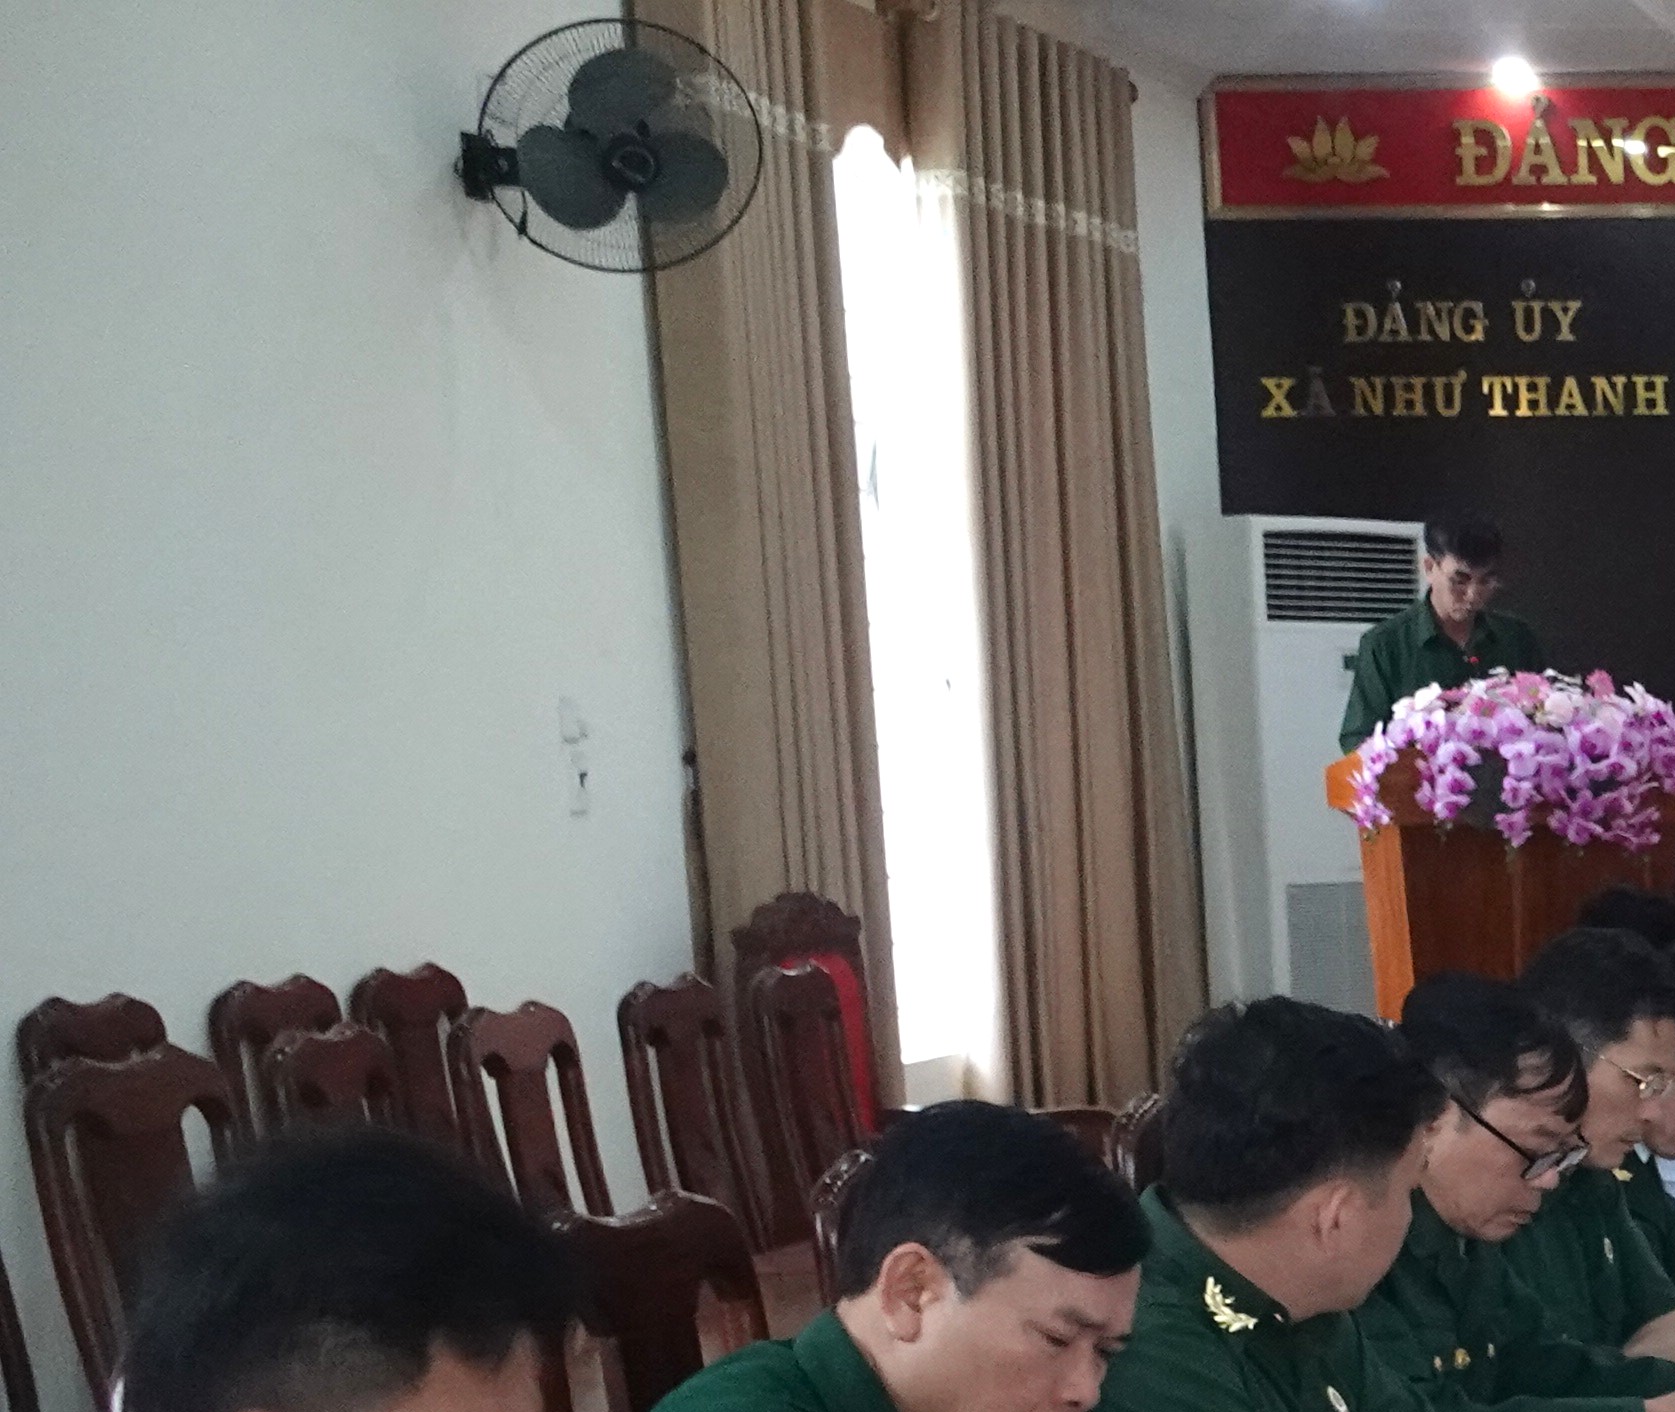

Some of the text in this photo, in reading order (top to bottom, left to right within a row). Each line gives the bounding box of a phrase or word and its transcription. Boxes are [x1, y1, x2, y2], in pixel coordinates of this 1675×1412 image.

[1341, 279, 1583, 343] ĐẢNG ỦY
[1259, 366, 1671, 418] XÃ NHƯ THANH
